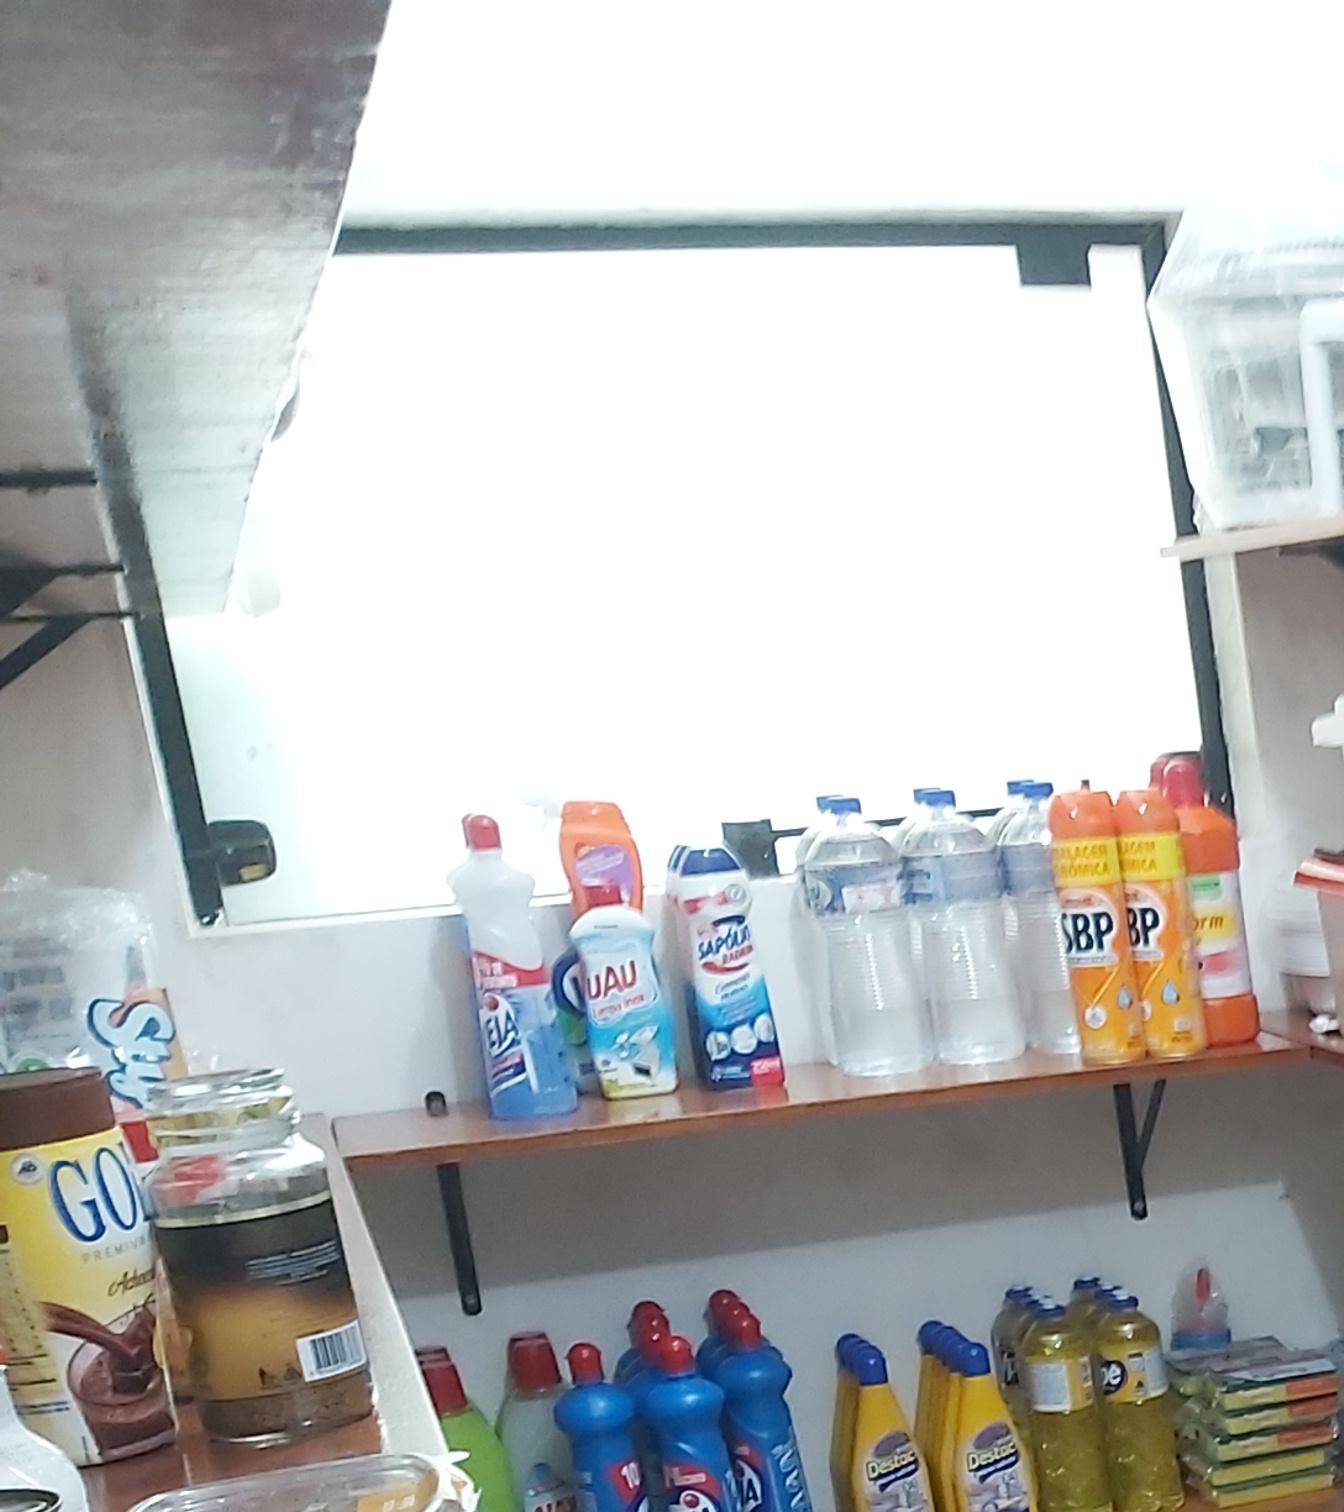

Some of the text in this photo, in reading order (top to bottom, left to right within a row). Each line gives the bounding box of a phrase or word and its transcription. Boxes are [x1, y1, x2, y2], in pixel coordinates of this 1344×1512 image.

[1061, 911, 1114, 955] SBP
[1126, 907, 1160, 947] BP
[586, 959, 638, 1001] UAU
[484, 1009, 520, 1050] EJA
